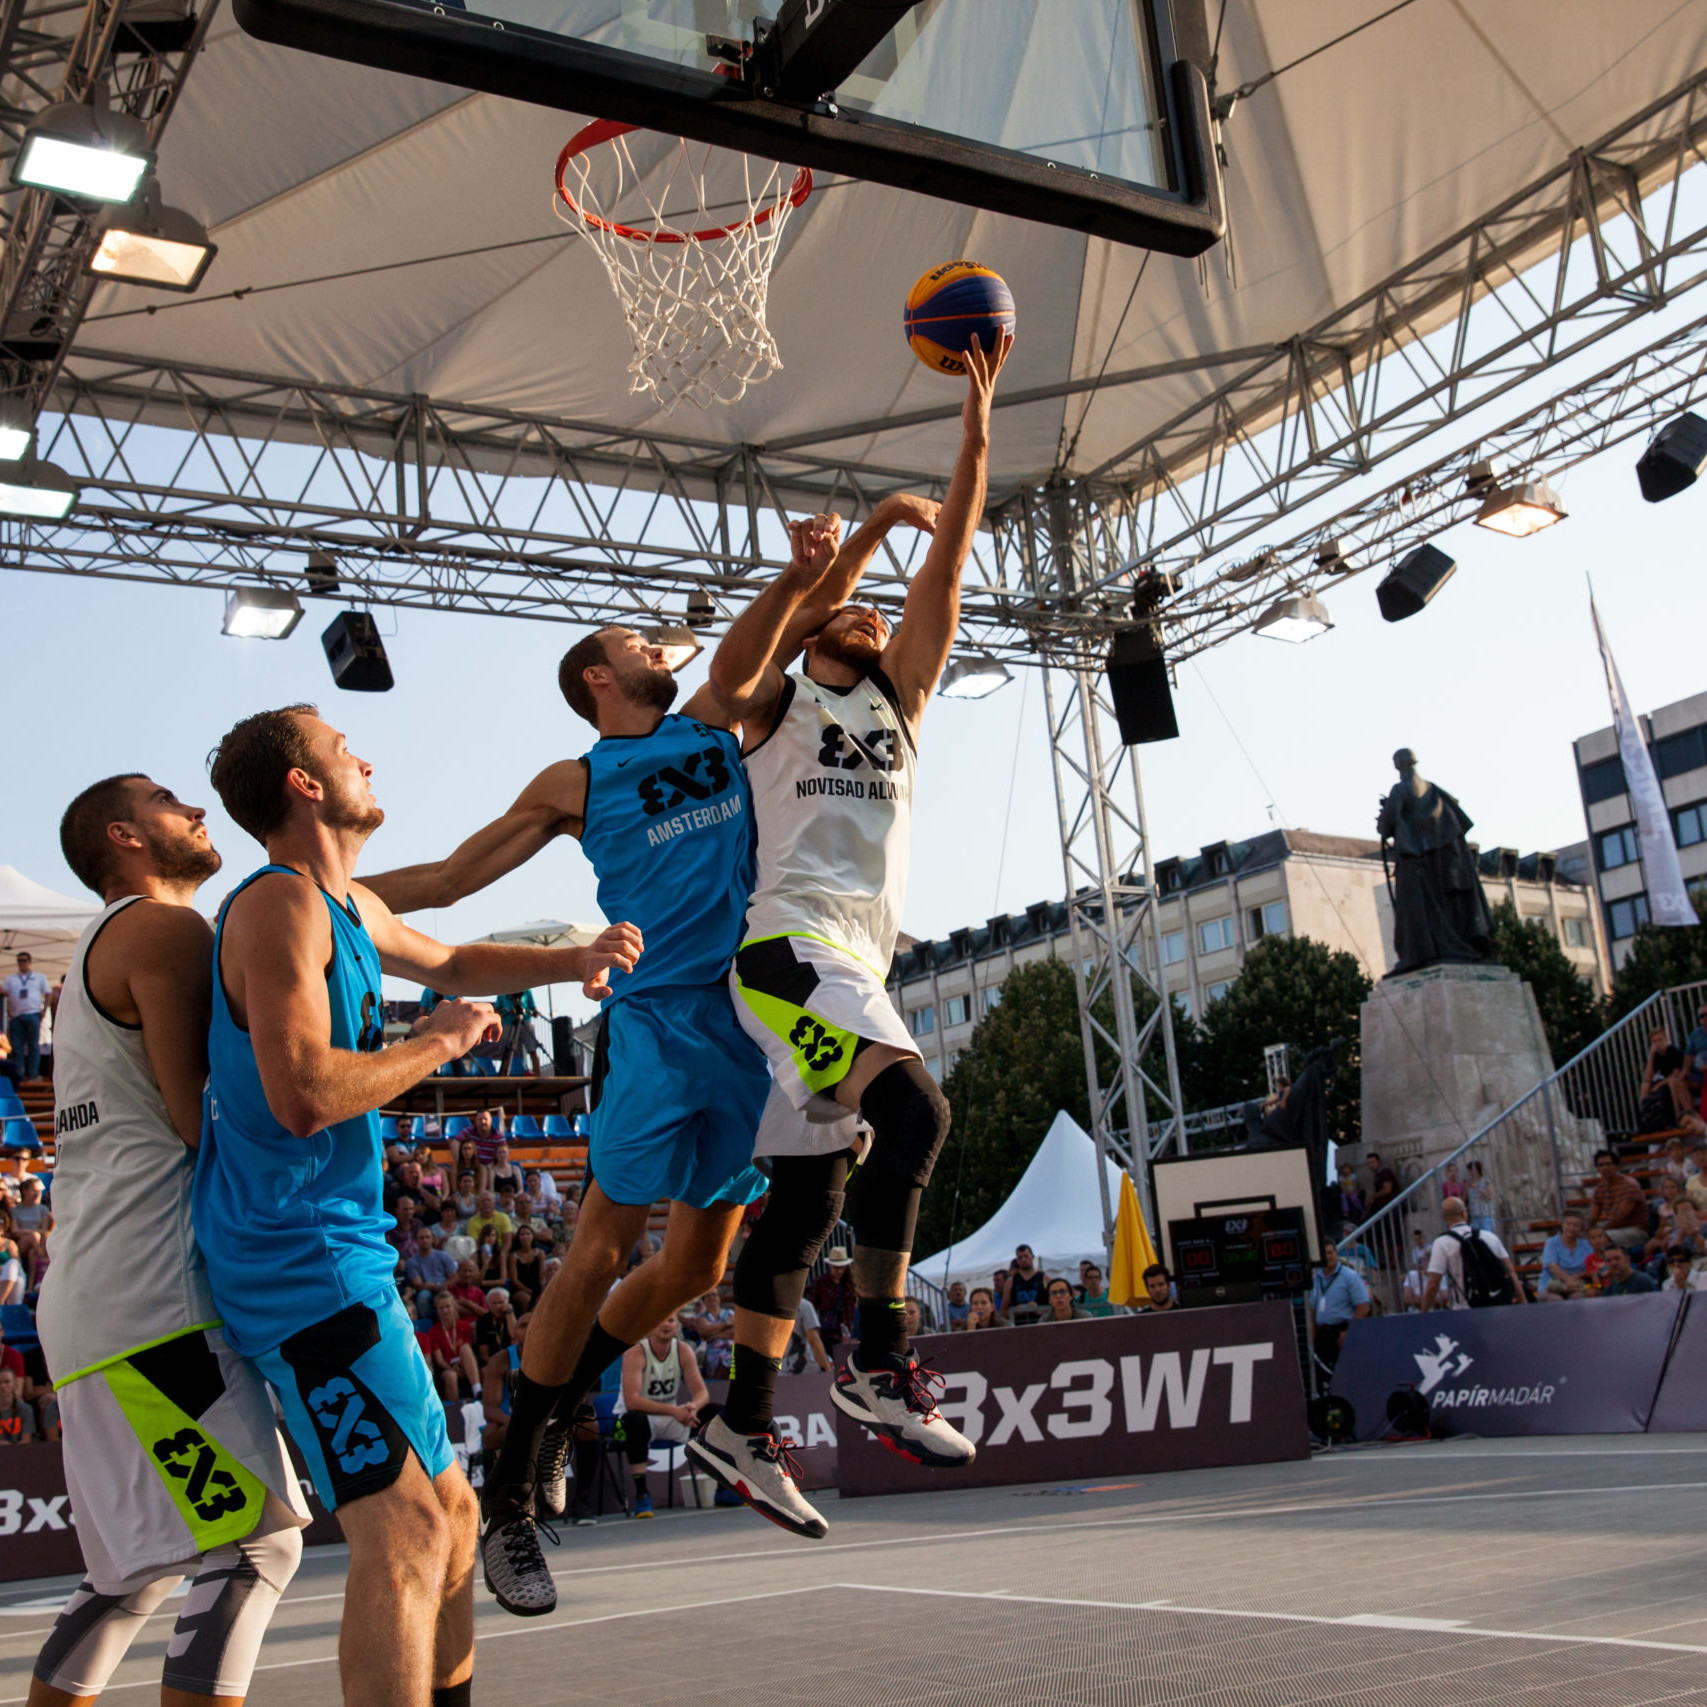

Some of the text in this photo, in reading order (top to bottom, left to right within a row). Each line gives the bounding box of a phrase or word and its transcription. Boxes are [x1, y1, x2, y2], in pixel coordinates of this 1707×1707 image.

[796, 778, 864, 799] NOVISAD
[646, 794, 741, 847] AMSTERDAM
[861, 1342, 1274, 1447] 3x3WT
[1432, 1382, 1555, 1408] PAPÍRMADÁR
[773, 1412, 838, 1449] BA
